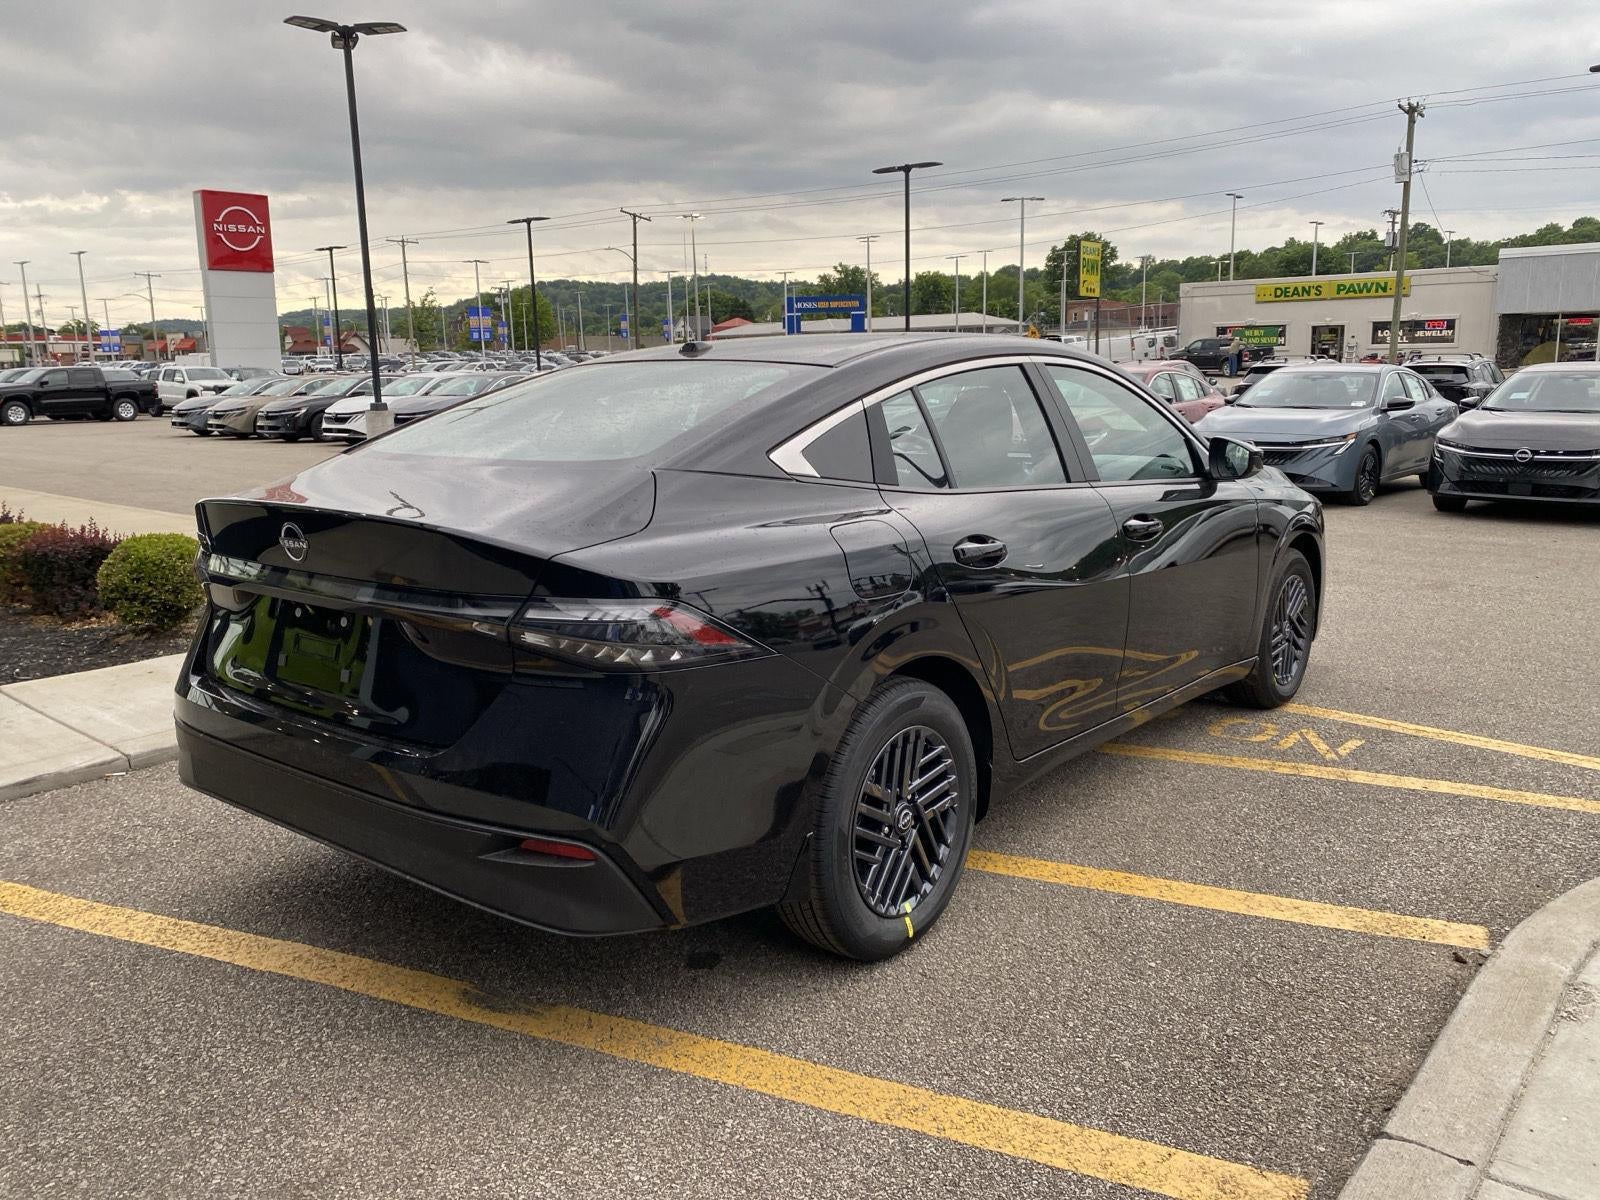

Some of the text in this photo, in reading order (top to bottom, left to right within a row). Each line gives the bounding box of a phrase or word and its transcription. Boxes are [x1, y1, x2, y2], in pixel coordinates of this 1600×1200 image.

[213, 223, 265, 234] NISSAN
[1082, 257, 1099, 276] PAWN
[794, 301, 817, 309] MOSES
[1426, 320, 1446, 329] OPEN
[1377, 329, 1403, 337] LON
[1415, 329, 1454, 337] JEWELRY
